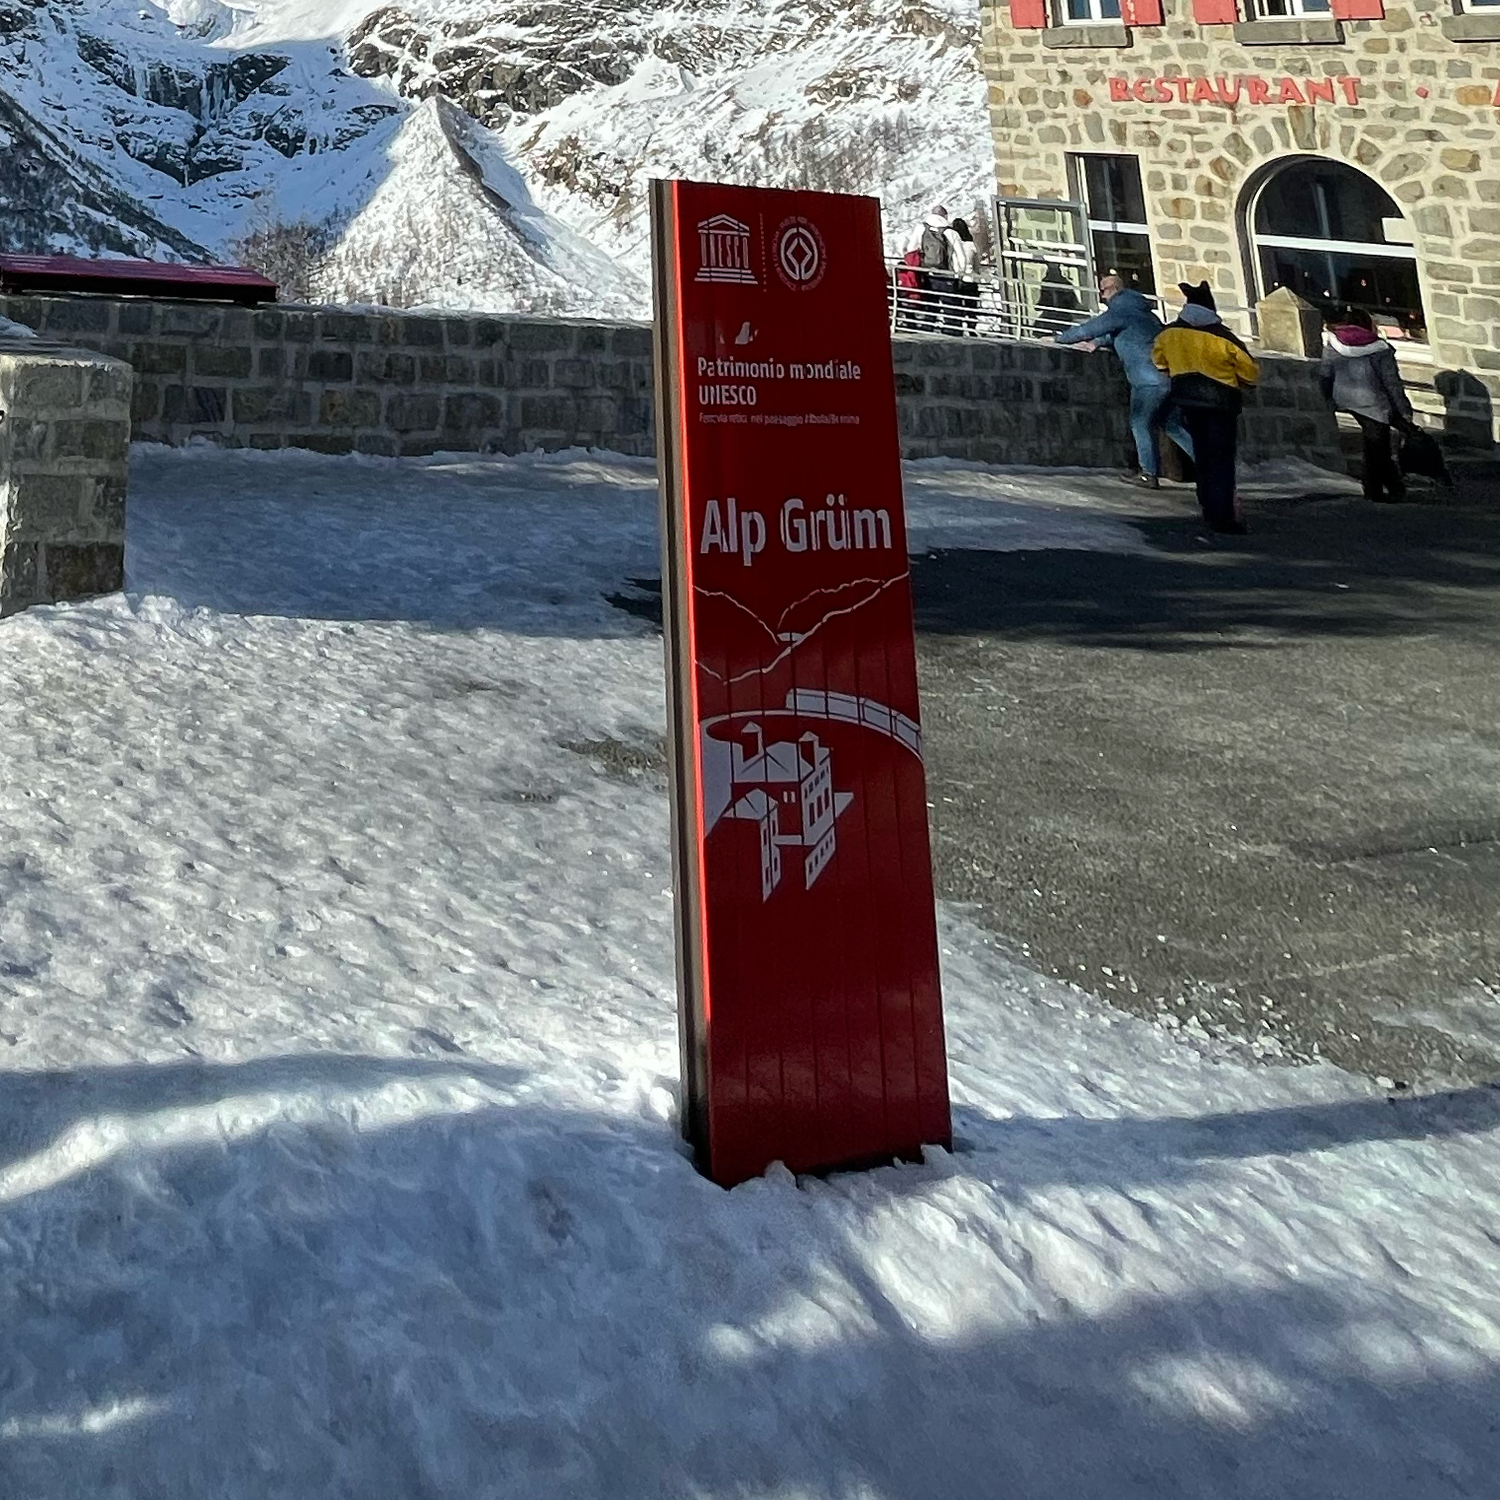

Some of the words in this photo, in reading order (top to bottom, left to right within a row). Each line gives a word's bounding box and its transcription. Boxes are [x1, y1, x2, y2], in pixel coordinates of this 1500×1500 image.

[1108, 76, 1360, 106] RESTAURANT
[700, 233, 750, 269] UNESCO
[697, 356, 785, 379] Patrimonio
[790, 358, 862, 380] mondiale
[698, 384, 757, 406] UNESCO
[700, 497, 767, 567] Alp
[780, 493, 893, 553] Grüm
